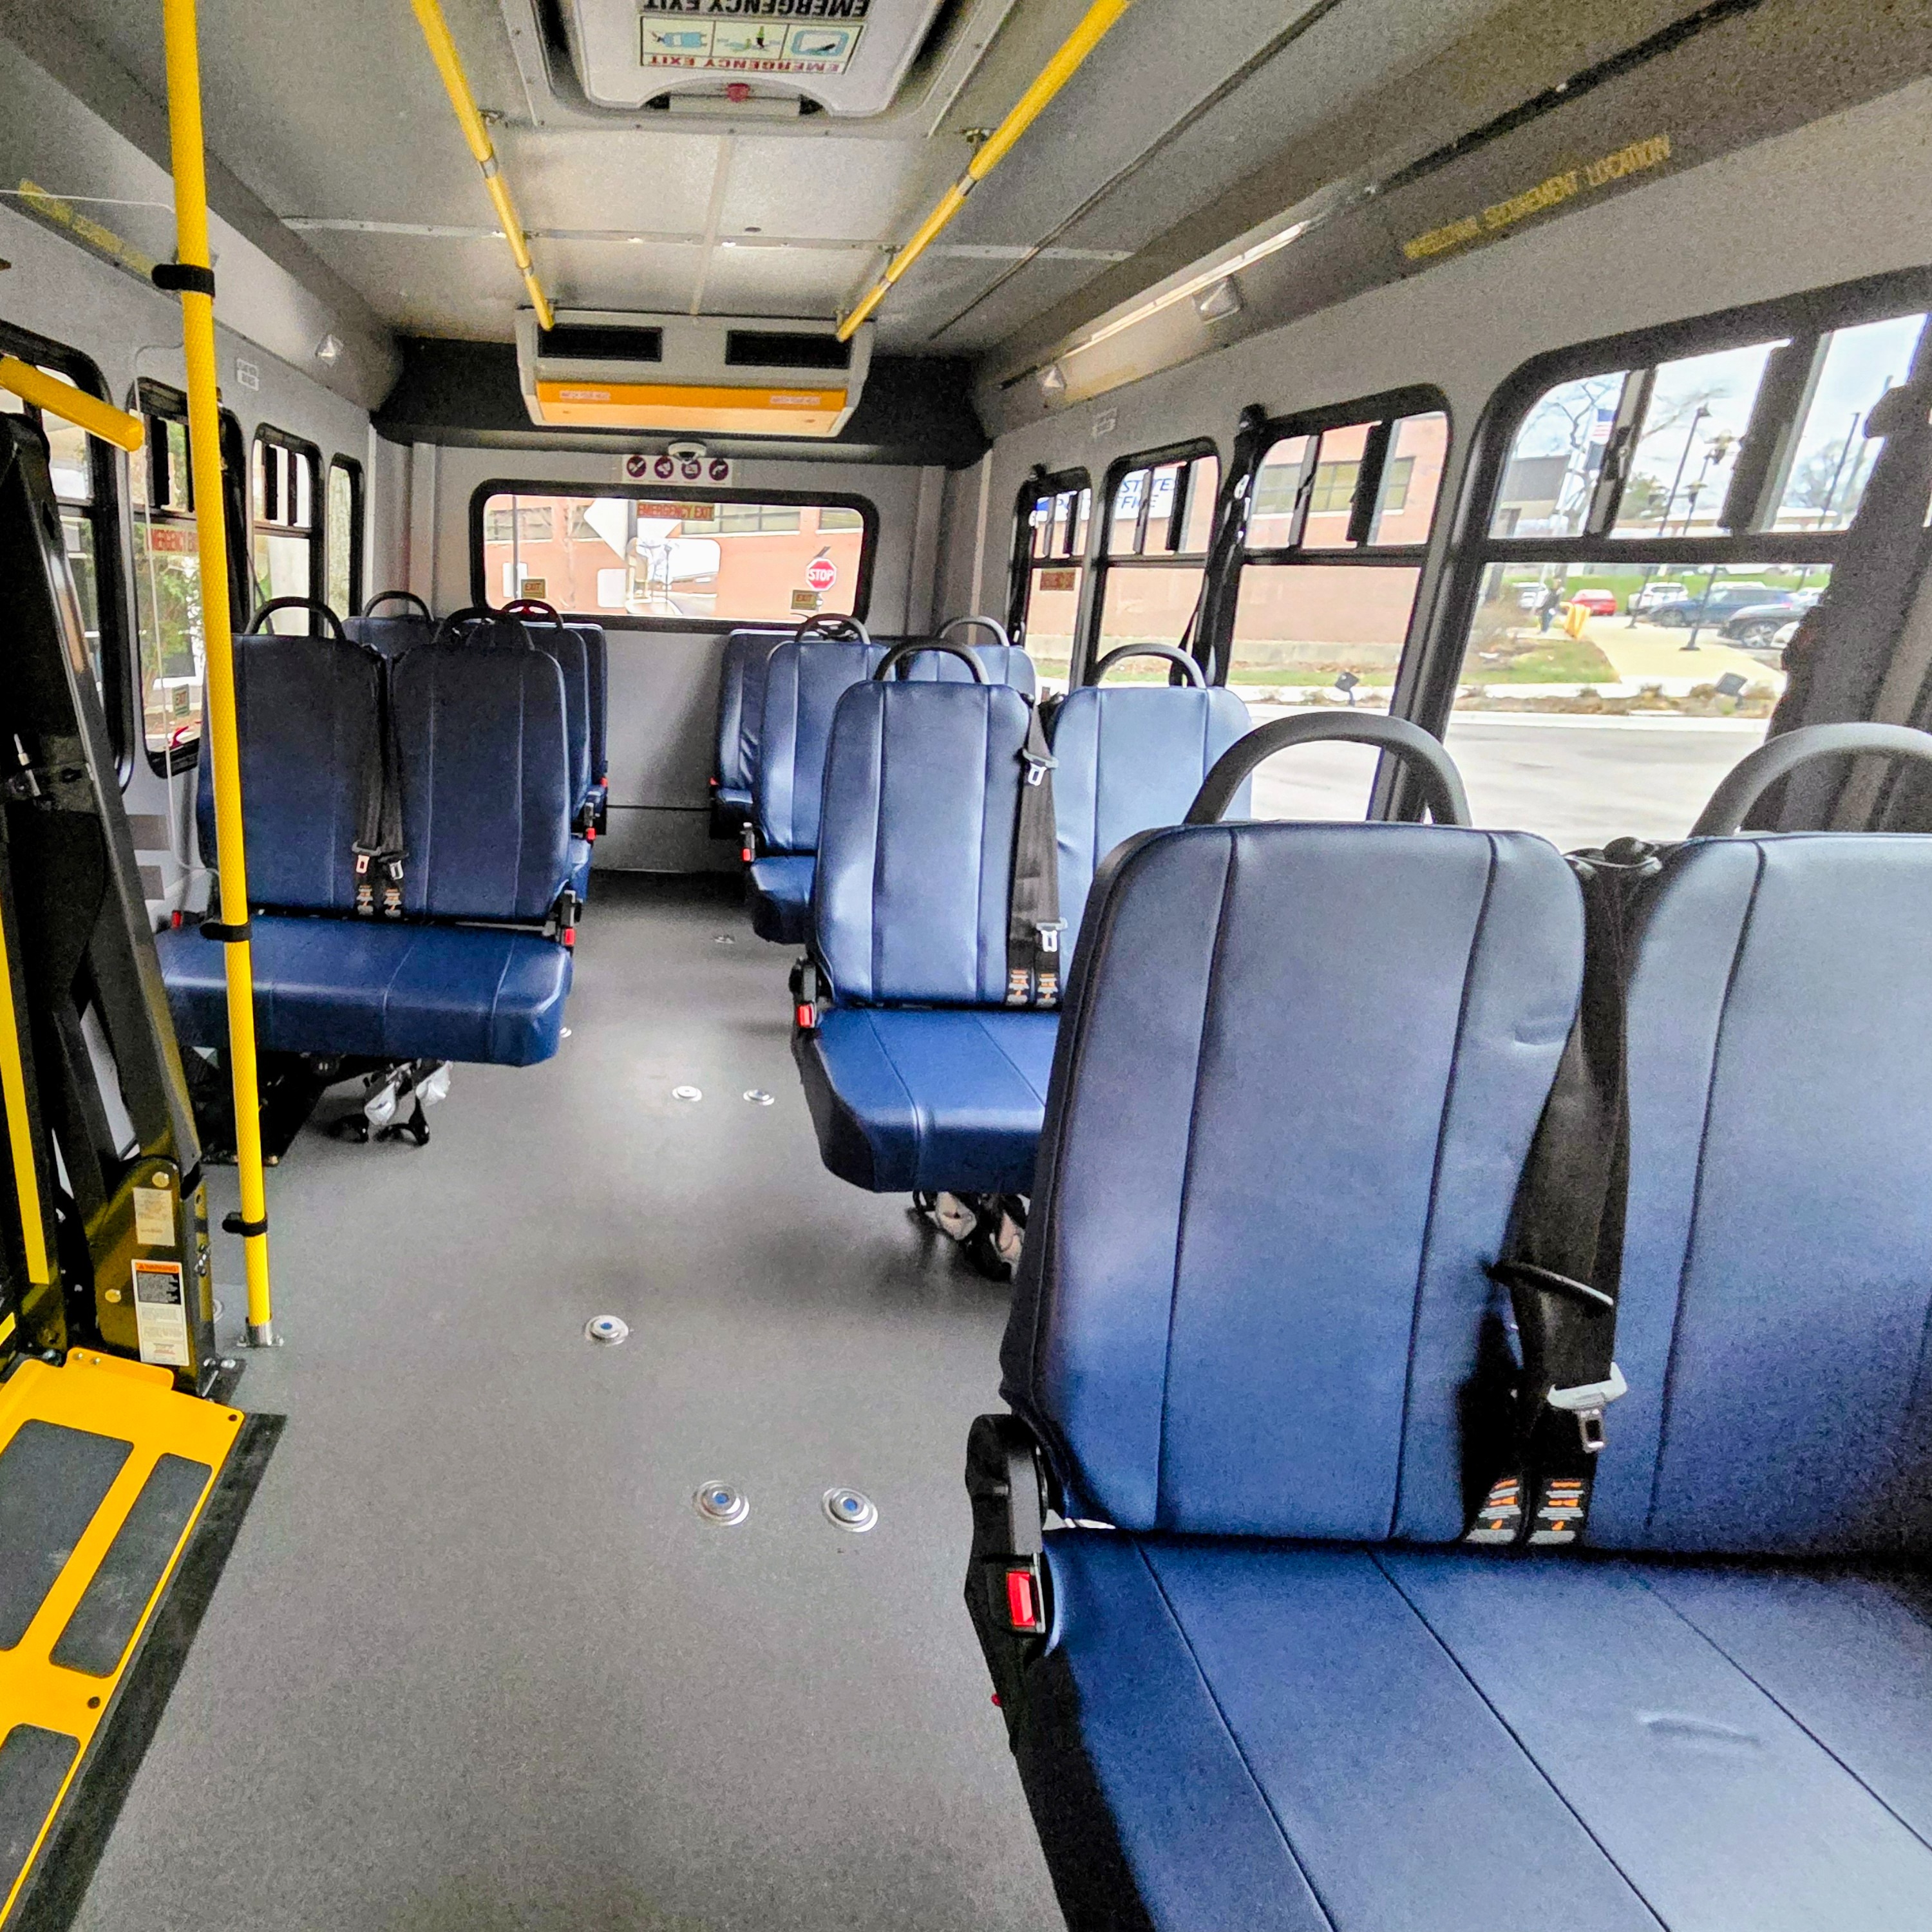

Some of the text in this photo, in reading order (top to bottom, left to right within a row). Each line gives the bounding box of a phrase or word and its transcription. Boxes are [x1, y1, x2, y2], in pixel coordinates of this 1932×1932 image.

[708, 0, 869, 17] EMERGENCY
[650, 57, 840, 72] EMERGENCY EXIT
[1586, 133, 1672, 187] LOCATION
[638, 504, 714, 519] EMERGENCY EXIT
[808, 569, 834, 581] STOP
